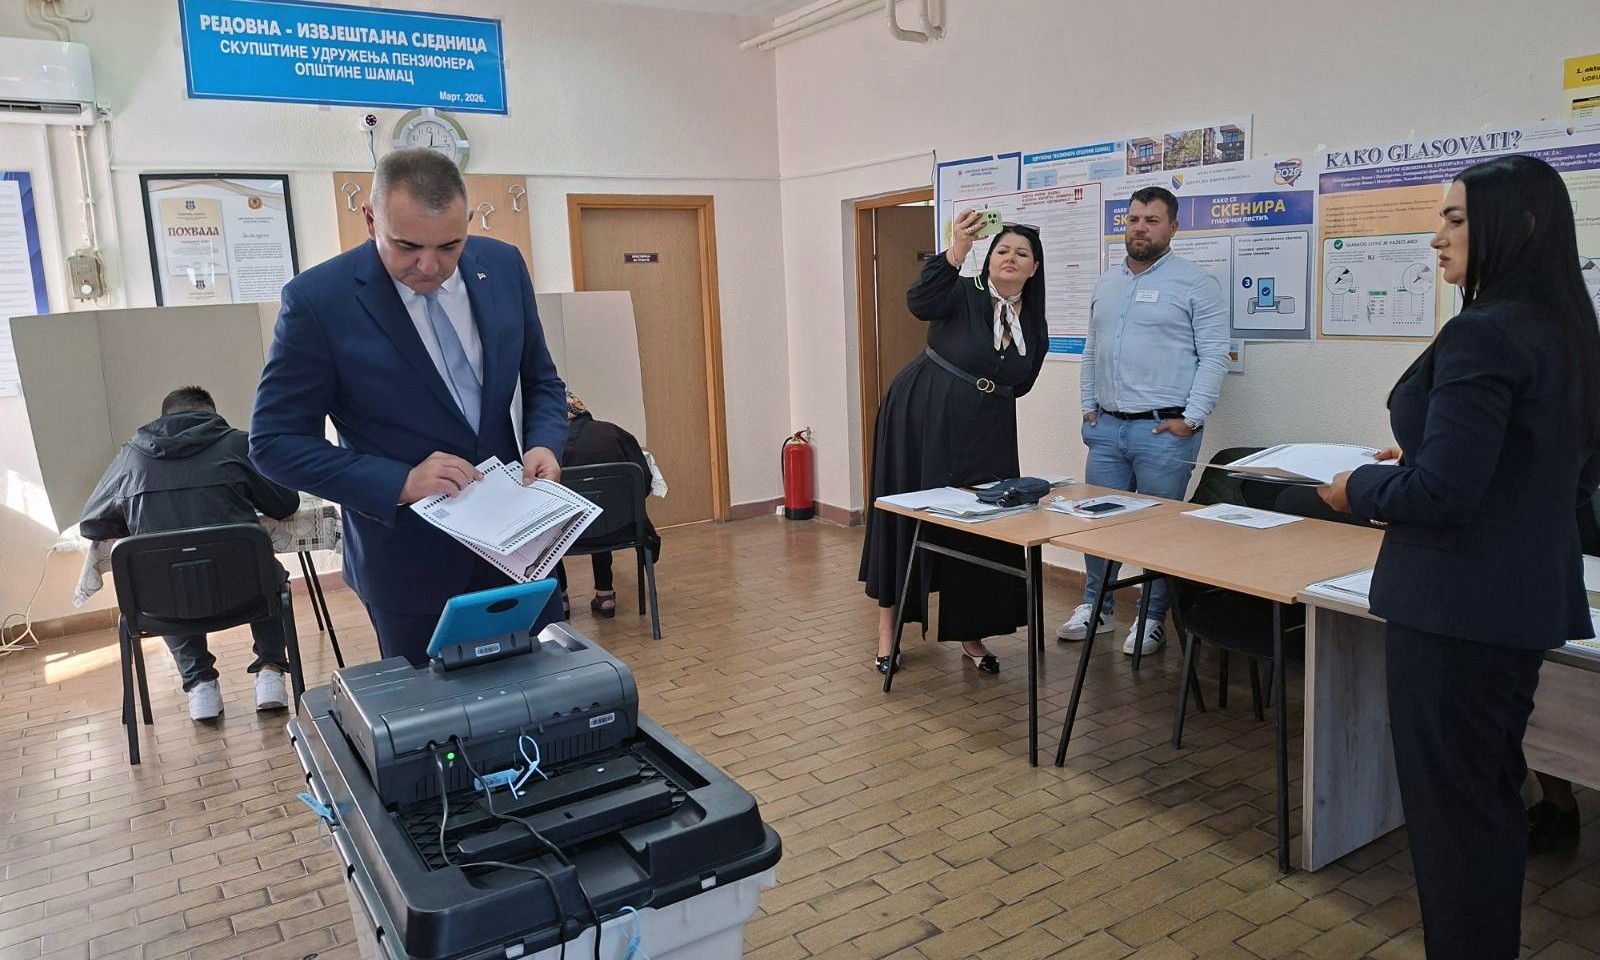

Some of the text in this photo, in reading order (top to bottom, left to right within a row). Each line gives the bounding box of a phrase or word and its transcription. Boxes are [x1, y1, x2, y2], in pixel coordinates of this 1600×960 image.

[200, 14, 281, 36] РЕДОВНА
[297, 22, 408, 46] ИЗВЈЕШТАЈНА
[412, 30, 487, 53] СЈЕДНИЦА
[220, 39, 475, 71] СКУПШТИНЕ УДРУЖЕЊА ПЕНЗИОНЕРА
[295, 63, 414, 84] ОПШТИНЕ ШАМАЦ
[464, 92, 486, 103] 2026.
[1326, 147, 1384, 170] KAKO
[1388, 130, 1523, 162] GLASOVATI?
[1211, 199, 1286, 218] СКЕНИРА
[168, 226, 220, 237] ПОХВАЛА
